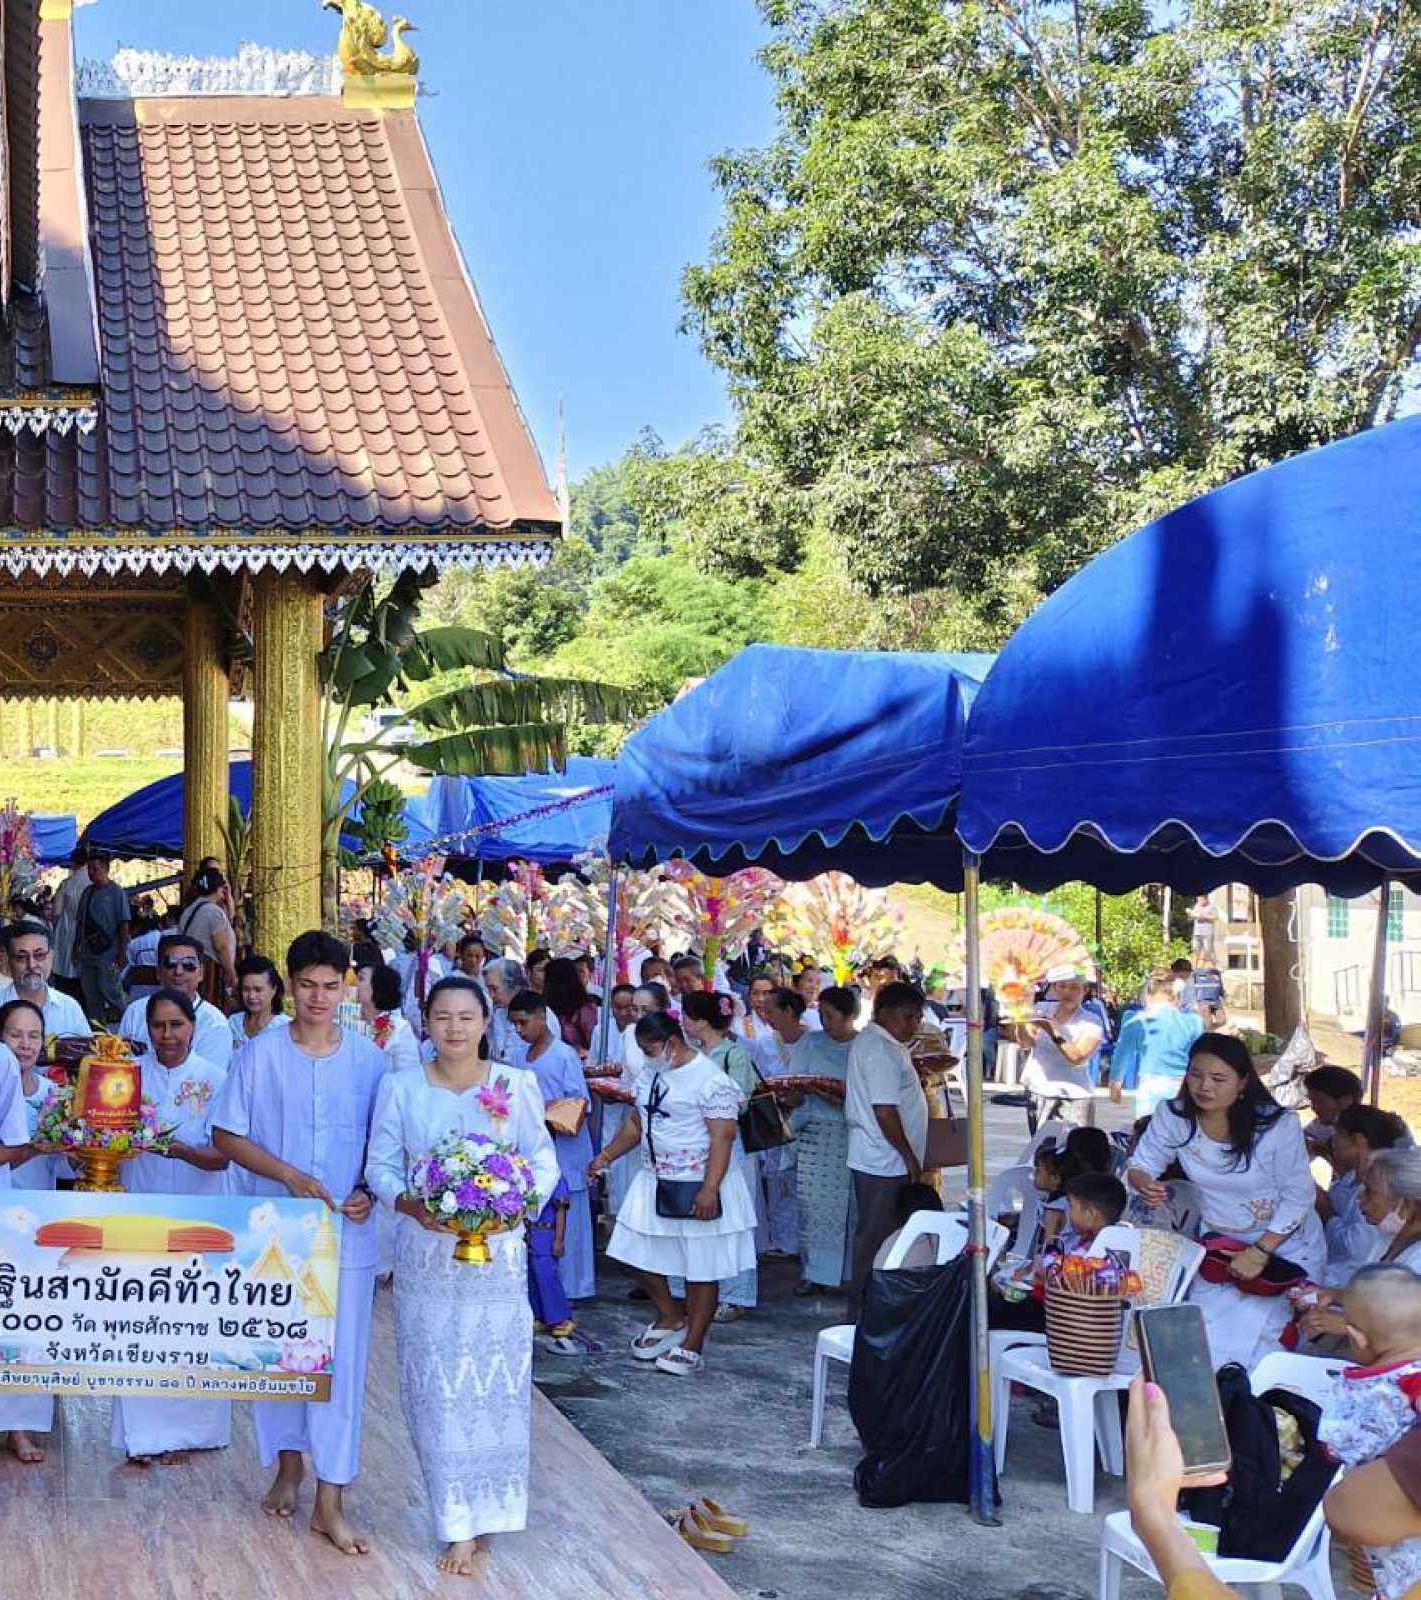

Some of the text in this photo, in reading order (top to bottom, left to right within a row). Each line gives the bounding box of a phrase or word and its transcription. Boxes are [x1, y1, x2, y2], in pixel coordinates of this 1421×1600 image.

[73, 1313, 96, 1333] วัด
[103, 1315, 209, 1340] พุทธศักราช
[218, 1317, 308, 1339] ๒๕๖๘
[46, 1341, 209, 1366] จังหวัดเชียงราย
